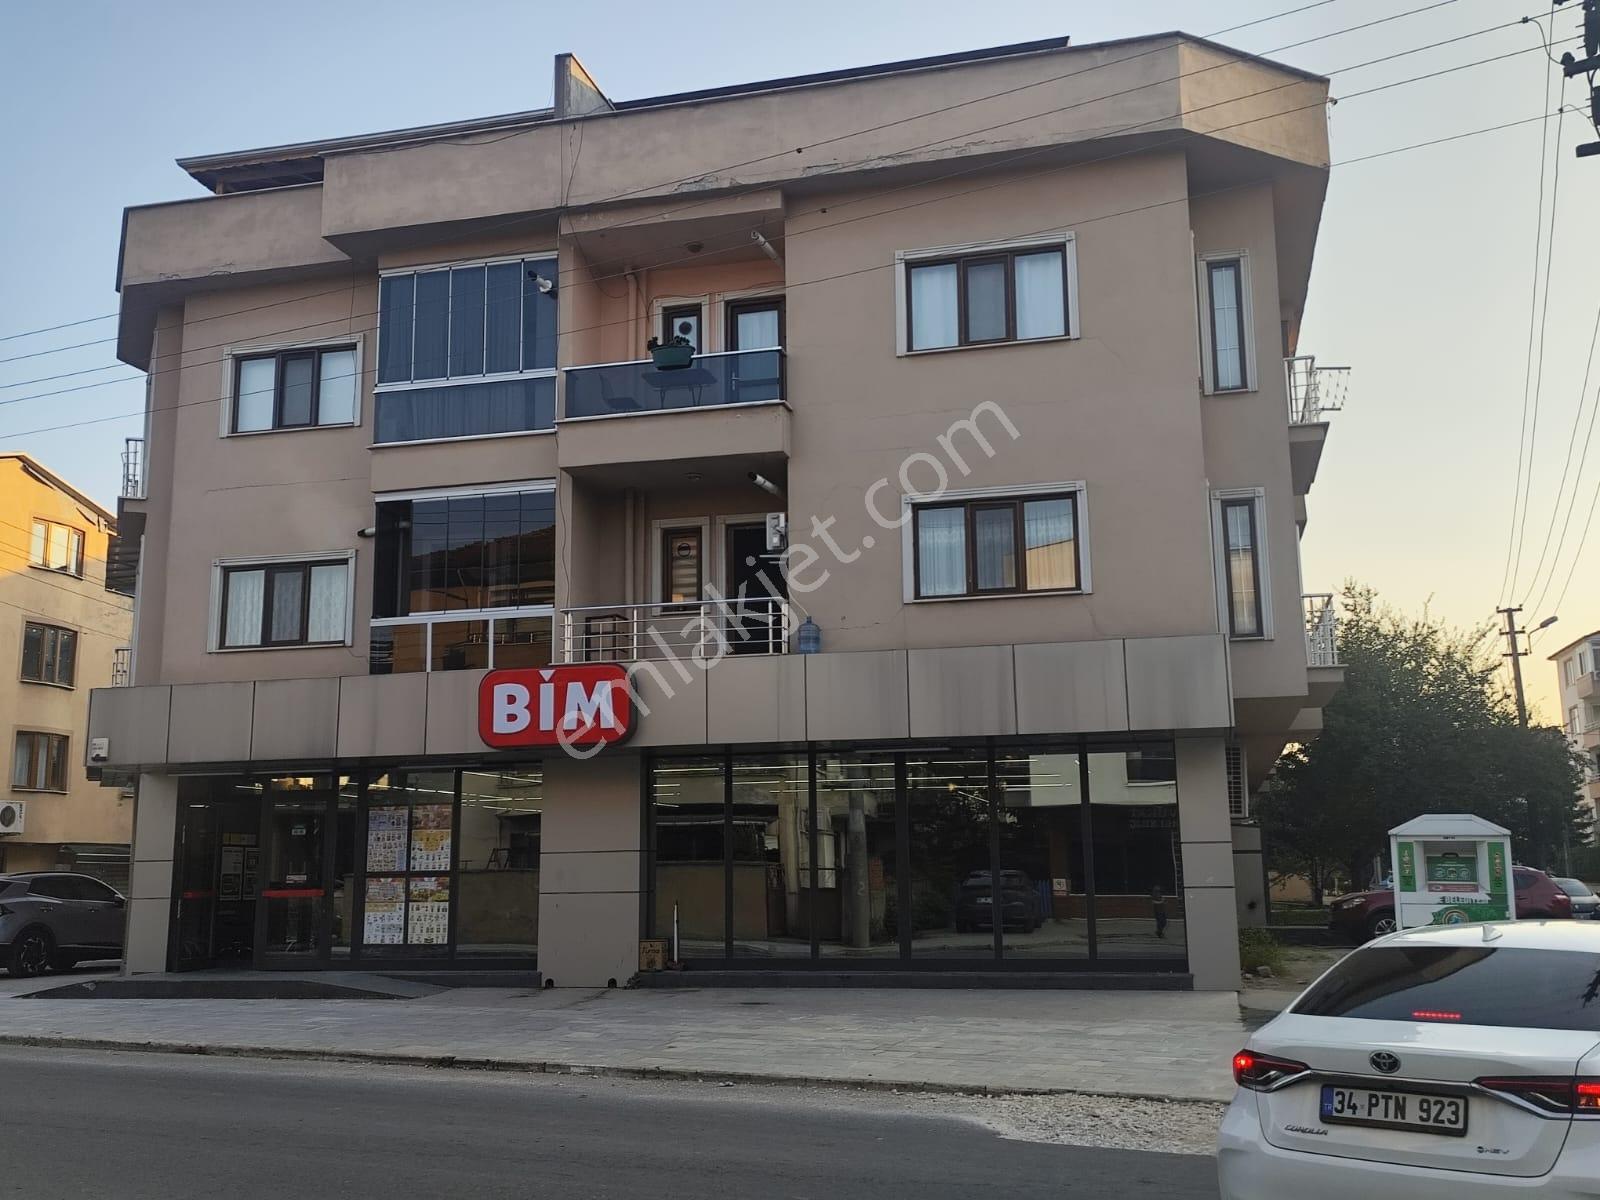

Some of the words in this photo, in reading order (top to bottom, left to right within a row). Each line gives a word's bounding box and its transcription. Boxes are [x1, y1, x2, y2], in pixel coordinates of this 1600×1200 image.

[492, 669, 616, 734] BİM
[1333, 1090, 1358, 1115] 34
[1367, 1093, 1406, 1120] PTN
[1418, 1098, 1460, 1125] 923
